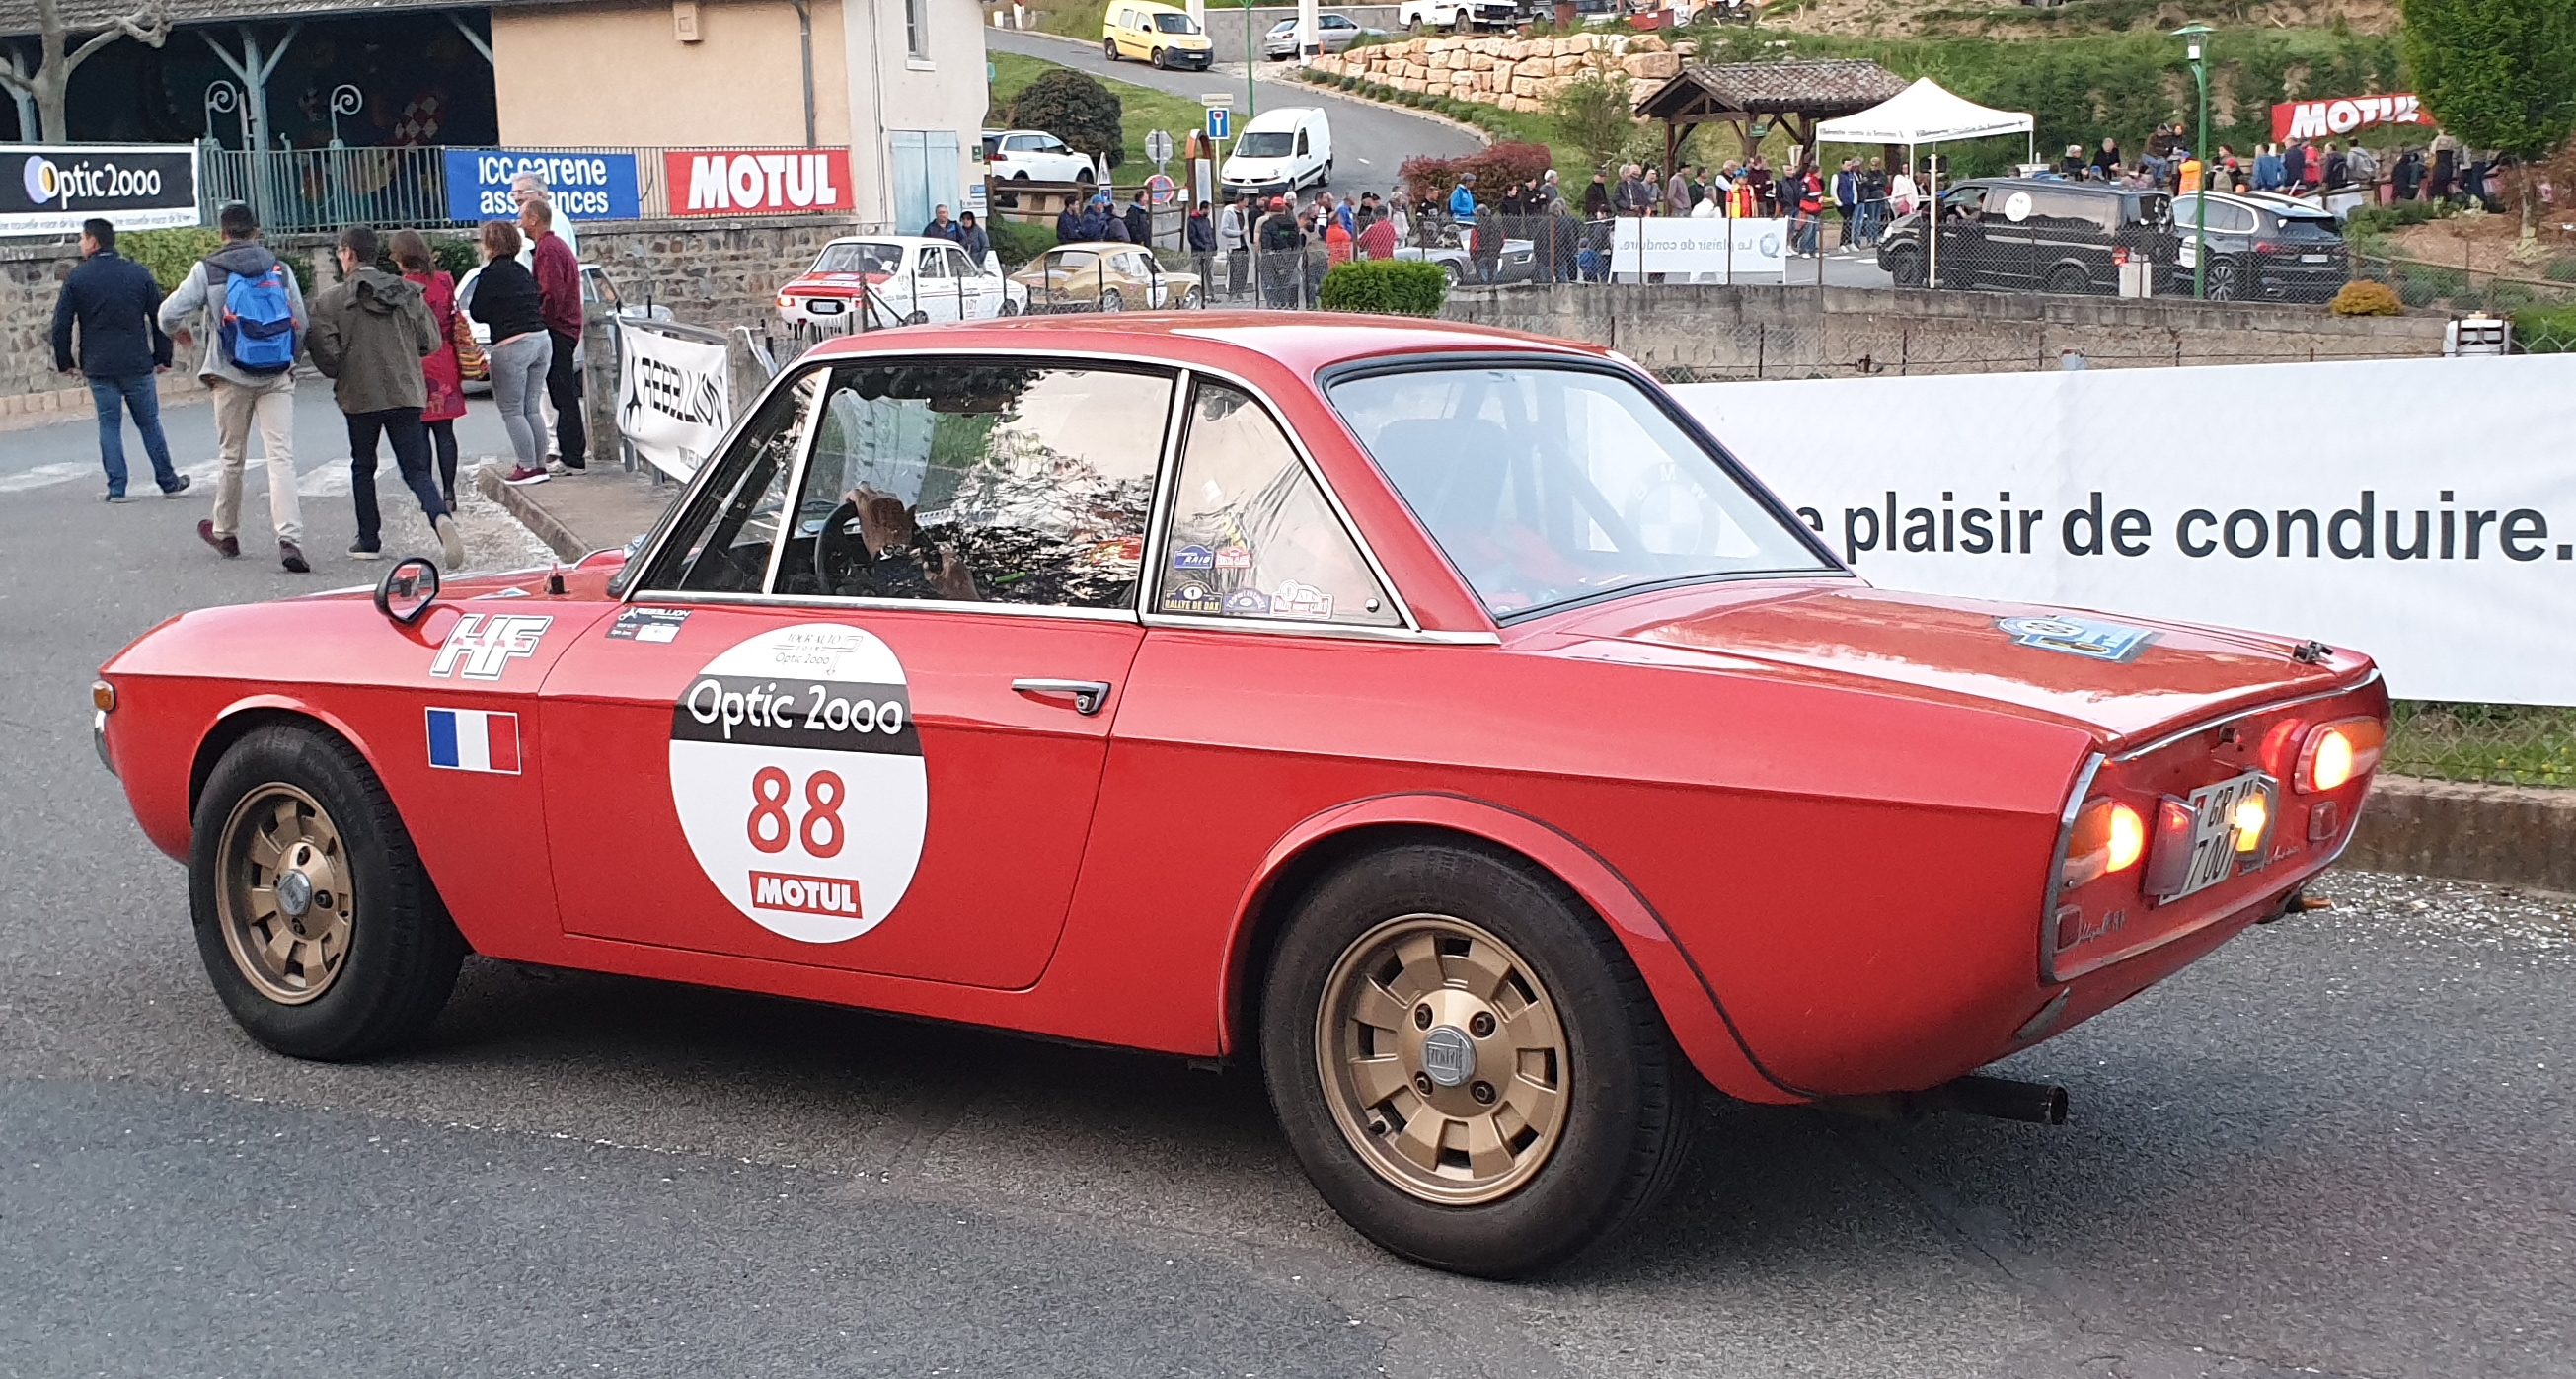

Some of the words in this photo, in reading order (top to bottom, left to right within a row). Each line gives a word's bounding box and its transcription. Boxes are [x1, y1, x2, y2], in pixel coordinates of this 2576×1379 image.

[478, 156, 514, 185] ICC
[687, 154, 837, 210] MOTUL
[480, 190, 609, 214] assances
[641, 356, 724, 432] REBELLION
[1844, 490, 2043, 565] plaisir
[2061, 491, 2152, 557] de
[2174, 489, 2574, 562] conduire.
[429, 613, 554, 681] HF
[775, 651, 803, 665] Optic
[803, 653, 830, 665] 2000
[687, 678, 795, 739] Optic
[803, 684, 903, 735] 2000
[746, 765, 846, 859] 88
[756, 876, 858, 913] MOTUL
